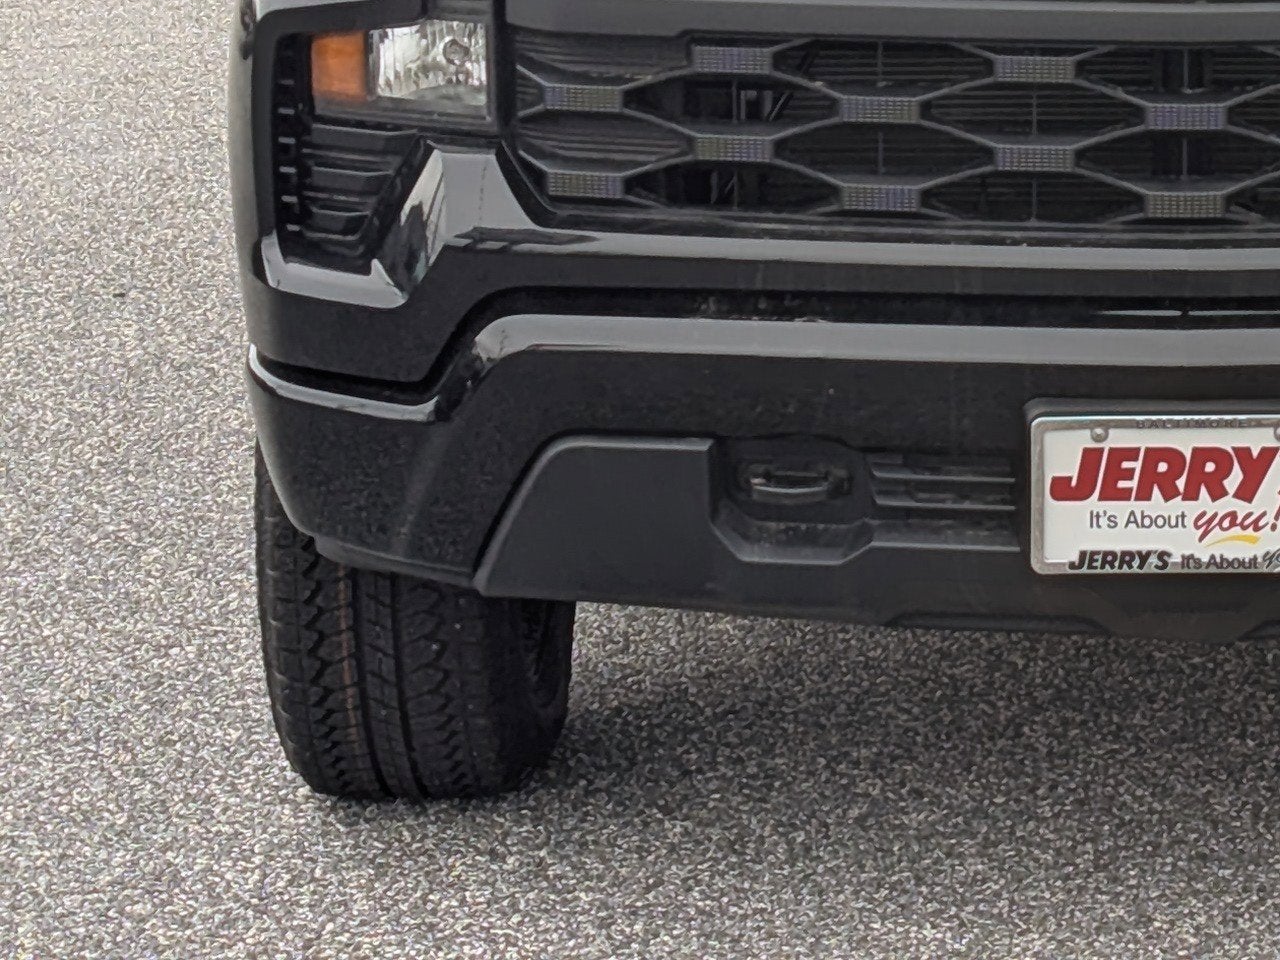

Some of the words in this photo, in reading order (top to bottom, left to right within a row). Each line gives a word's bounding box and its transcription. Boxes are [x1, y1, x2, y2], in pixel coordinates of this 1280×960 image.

[1089, 510, 1118, 529] It's
[1124, 510, 1188, 529] About
[1068, 549, 1173, 571] JERRY'S
[1181, 553, 1204, 570] It's
[1205, 553, 1258, 570] About
